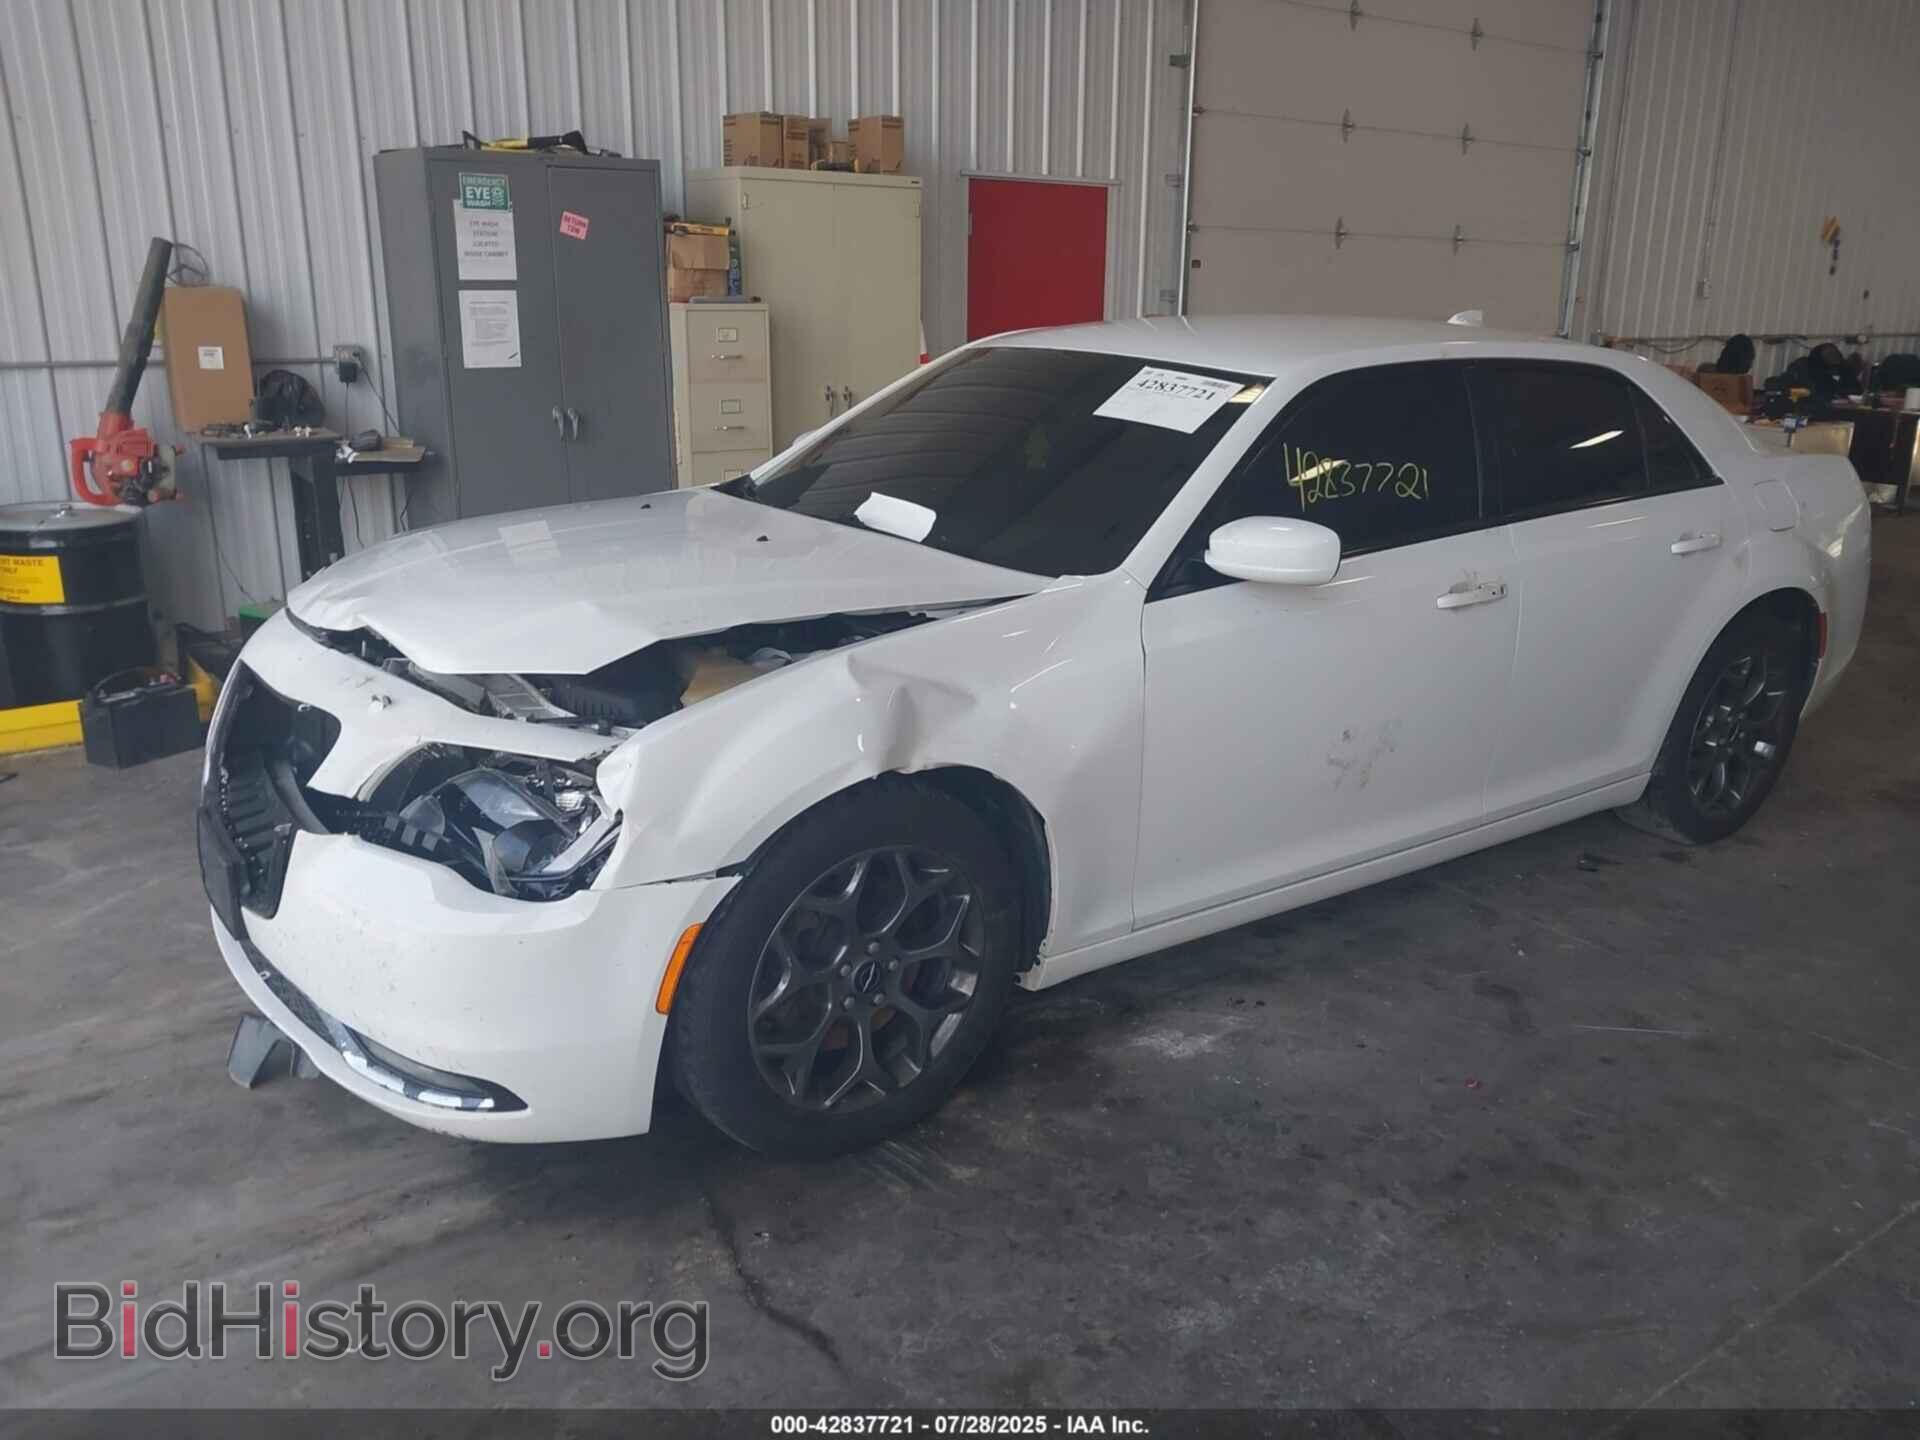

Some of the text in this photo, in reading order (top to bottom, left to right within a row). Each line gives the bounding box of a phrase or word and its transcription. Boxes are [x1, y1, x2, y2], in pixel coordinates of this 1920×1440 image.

[465, 186, 491, 200] EYE
[466, 200, 492, 208] WASH
[1137, 378, 1216, 401] 42837721
[1283, 442, 1430, 512] 42837721
